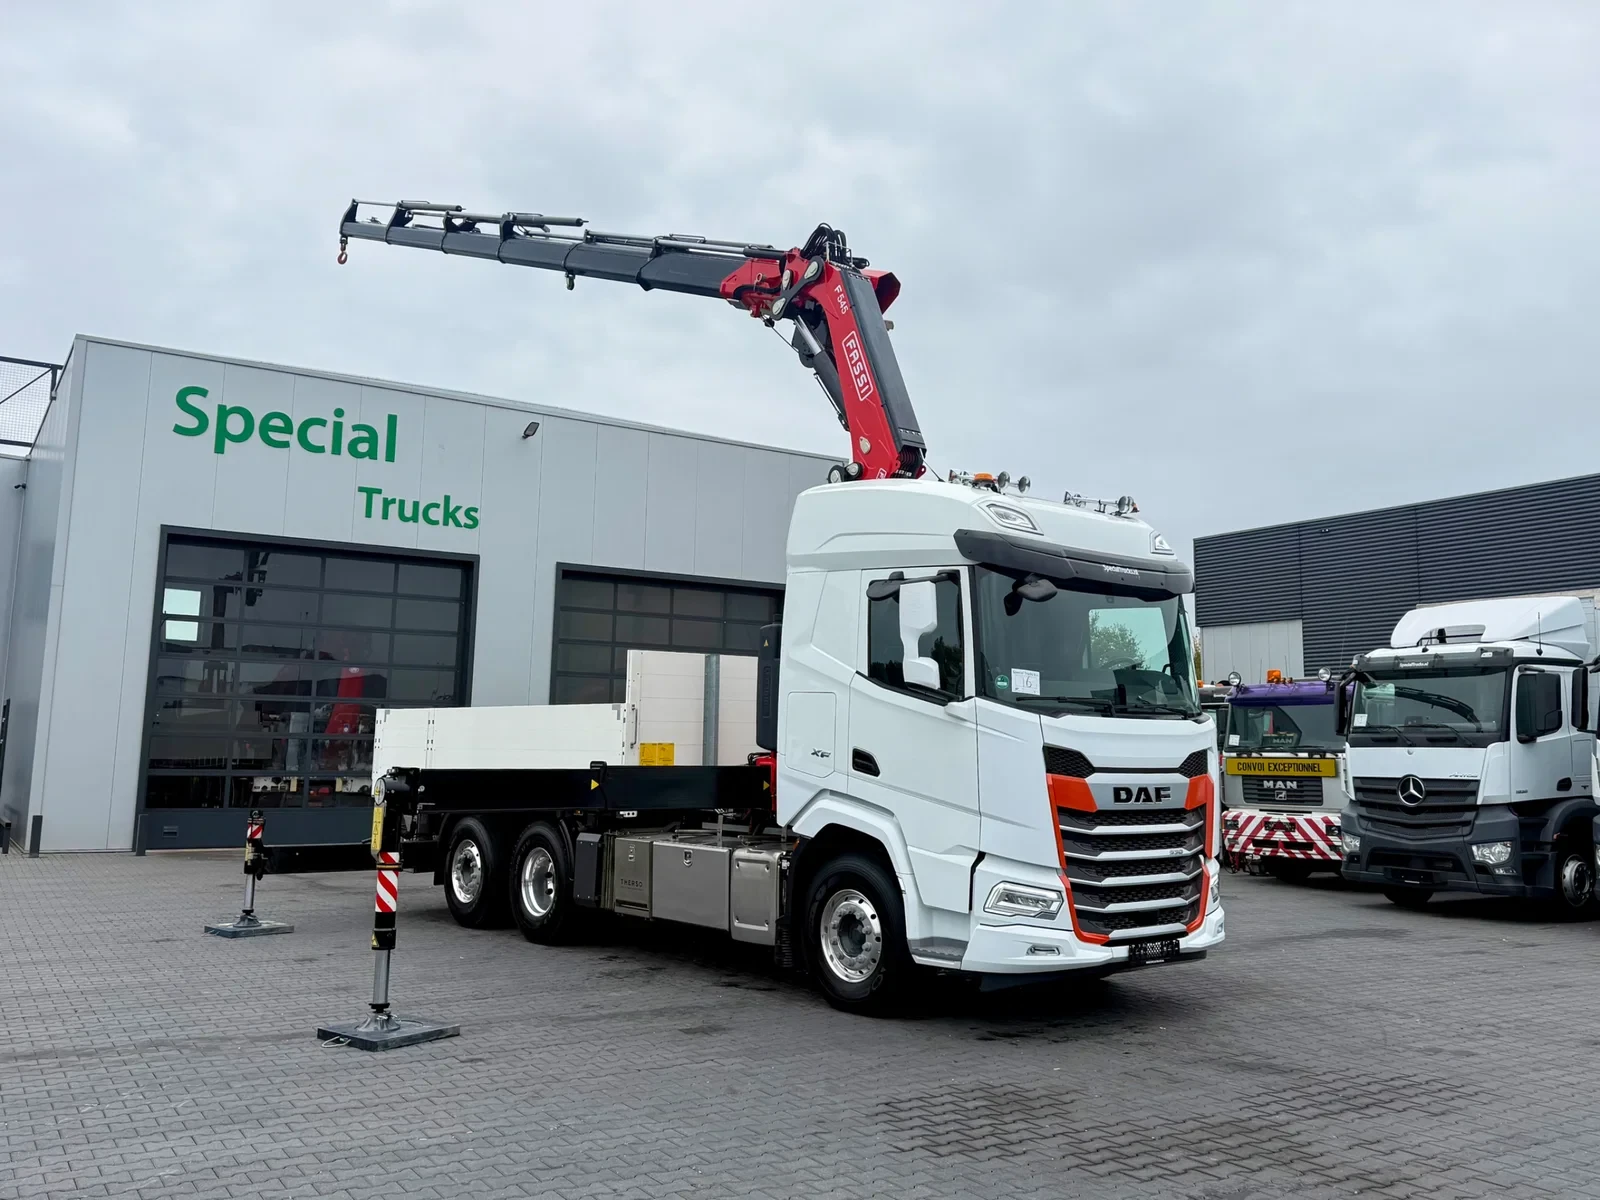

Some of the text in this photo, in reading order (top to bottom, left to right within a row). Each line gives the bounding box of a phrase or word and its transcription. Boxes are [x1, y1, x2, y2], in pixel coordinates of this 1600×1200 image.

[834, 284, 849, 315] F 545
[846, 338, 870, 394] FASSI
[172, 385, 398, 463] Special
[357, 485, 480, 529] Trucks
[1236, 762, 1323, 773] CONVOI EXCEPTIONNEL
[1113, 786, 1171, 804] DAF
[1263, 780, 1298, 789] MAN
